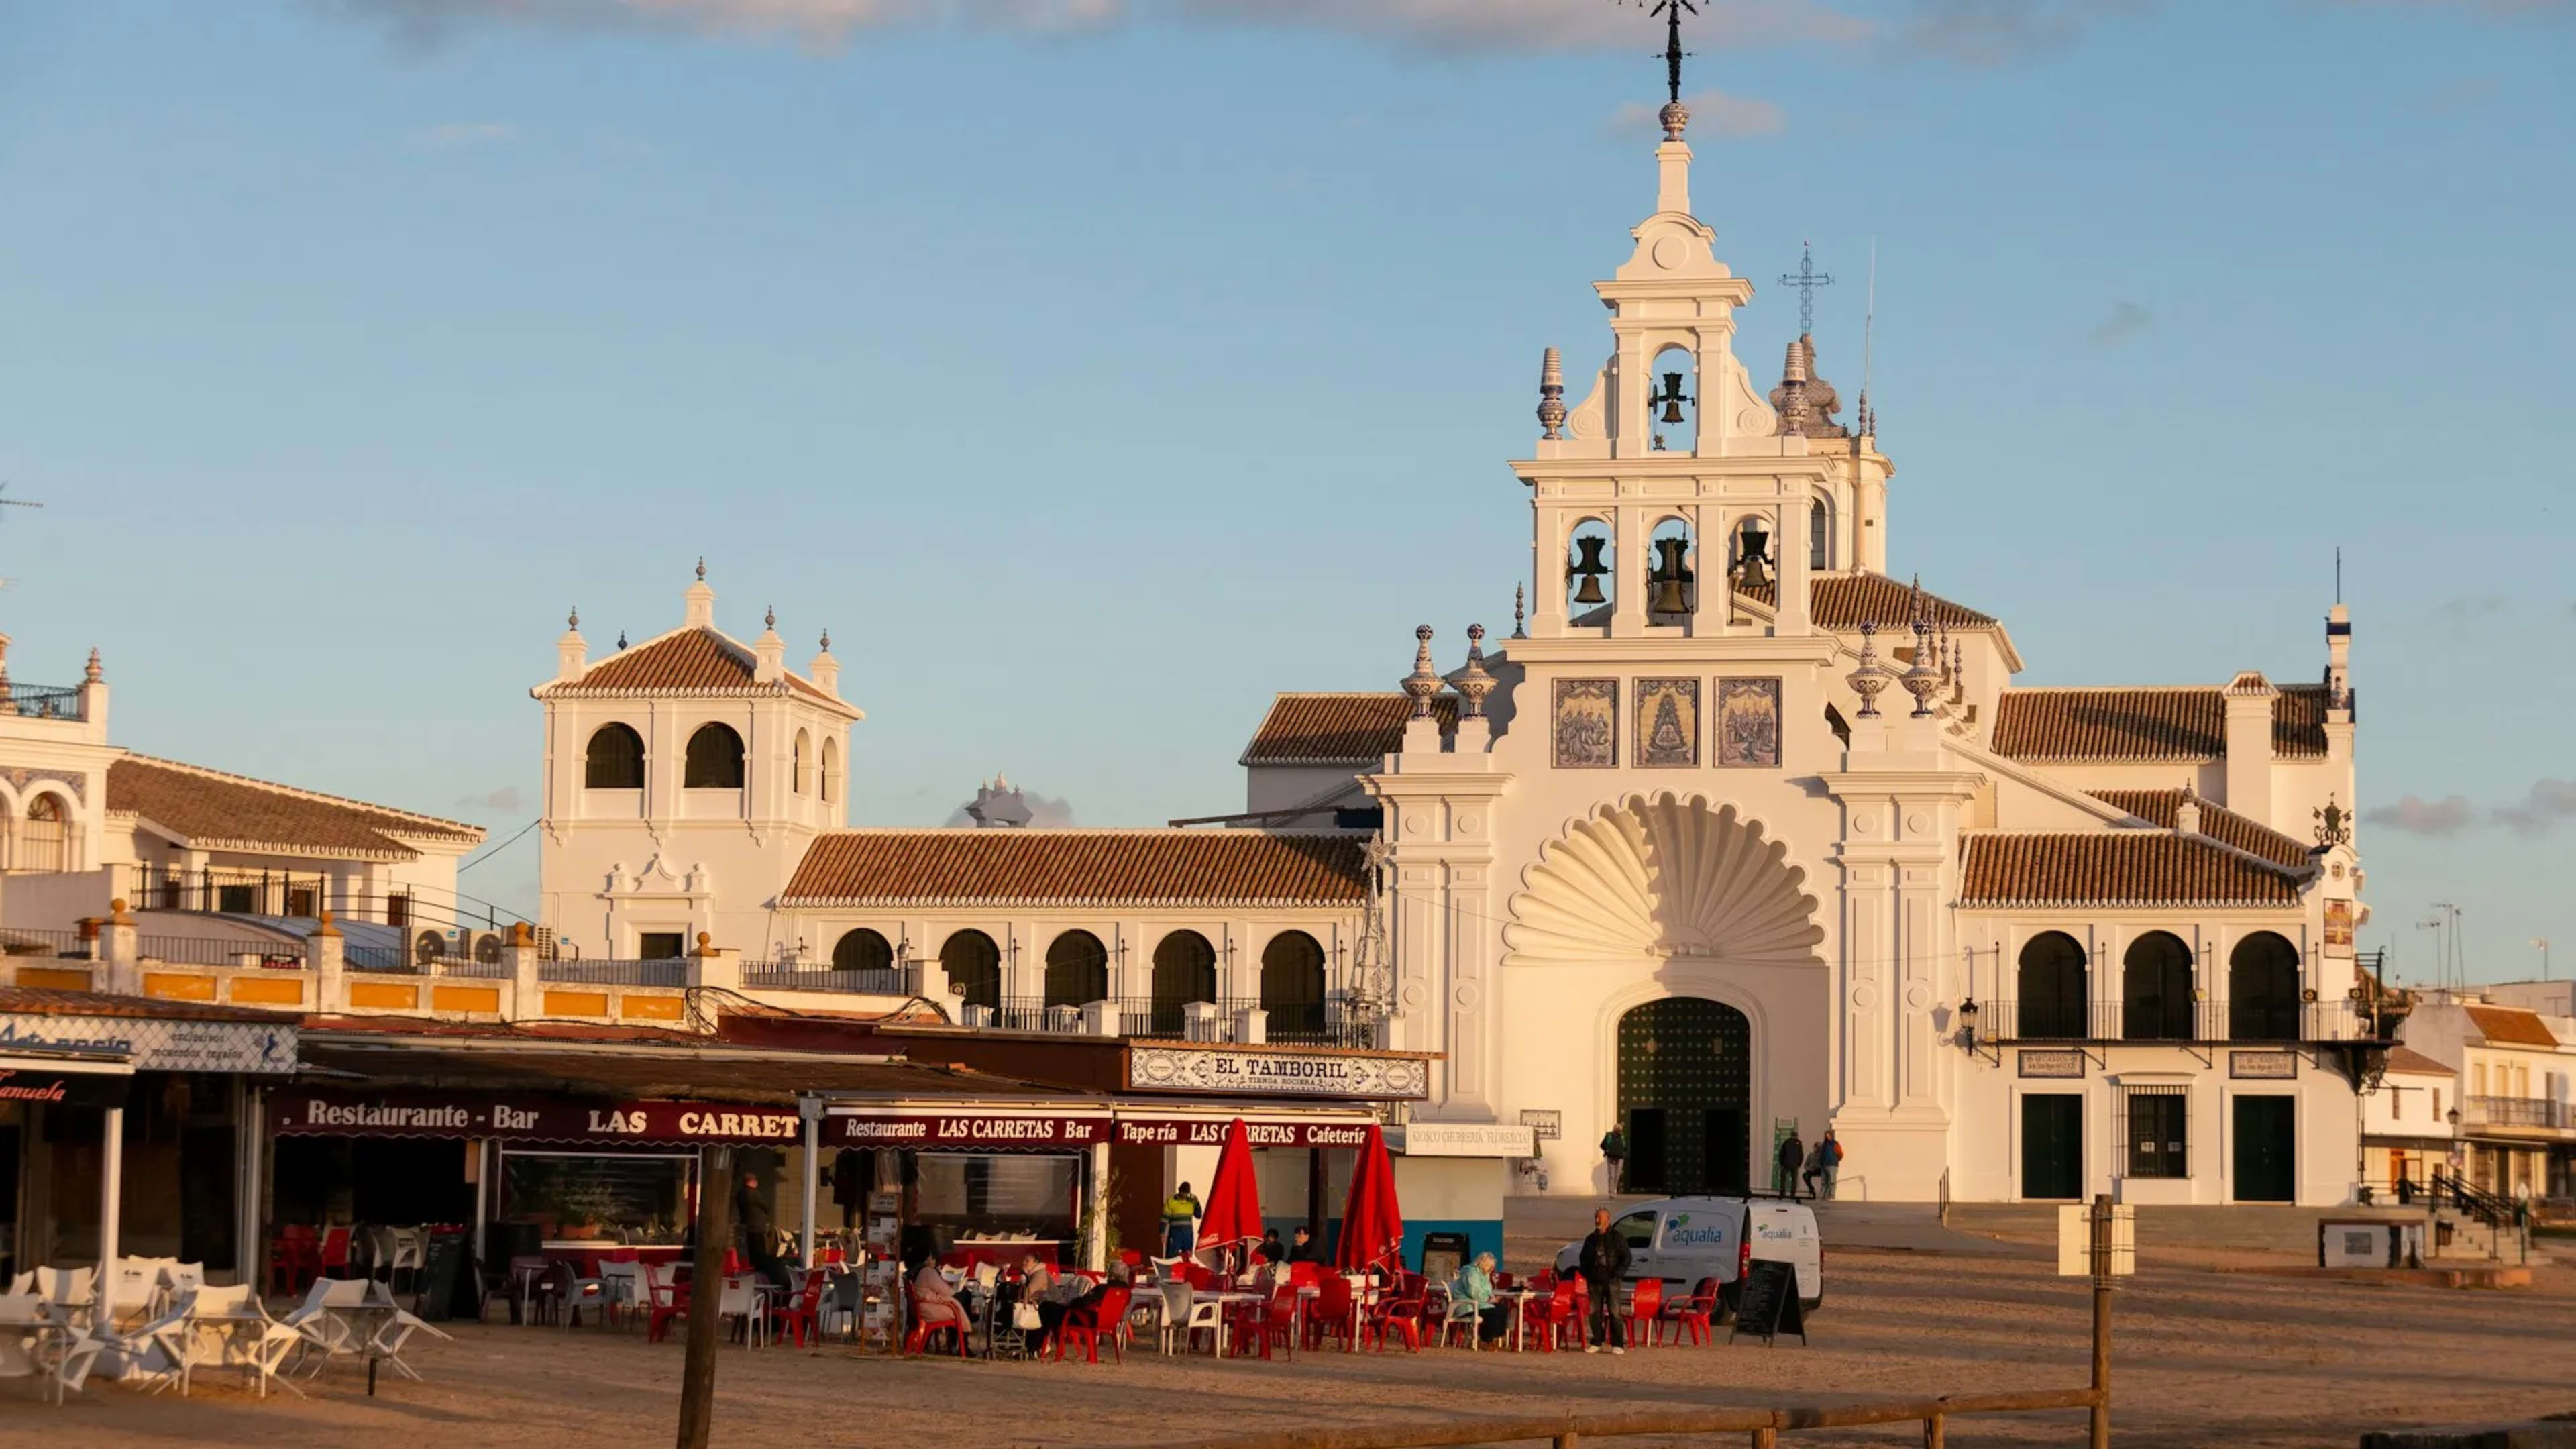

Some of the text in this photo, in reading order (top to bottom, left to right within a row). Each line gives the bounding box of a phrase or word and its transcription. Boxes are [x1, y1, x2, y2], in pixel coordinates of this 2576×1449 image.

[151, 1048, 201, 1059] recuerdos
[1214, 1058, 1348, 1079] EL TAMBORIL
[308, 1099, 469, 1128] Restaurante
[494, 1104, 539, 1129] Bar
[588, 1110, 647, 1134] LAS
[679, 1112, 800, 1138] CARRET
[846, 1118, 1092, 1139] Restaurante LAS CARRETAS Bar
[1191, 1124, 1218, 1142] LAS
[1673, 1226, 1722, 1246] aqualia
[1762, 1228, 1792, 1240] aqualia
